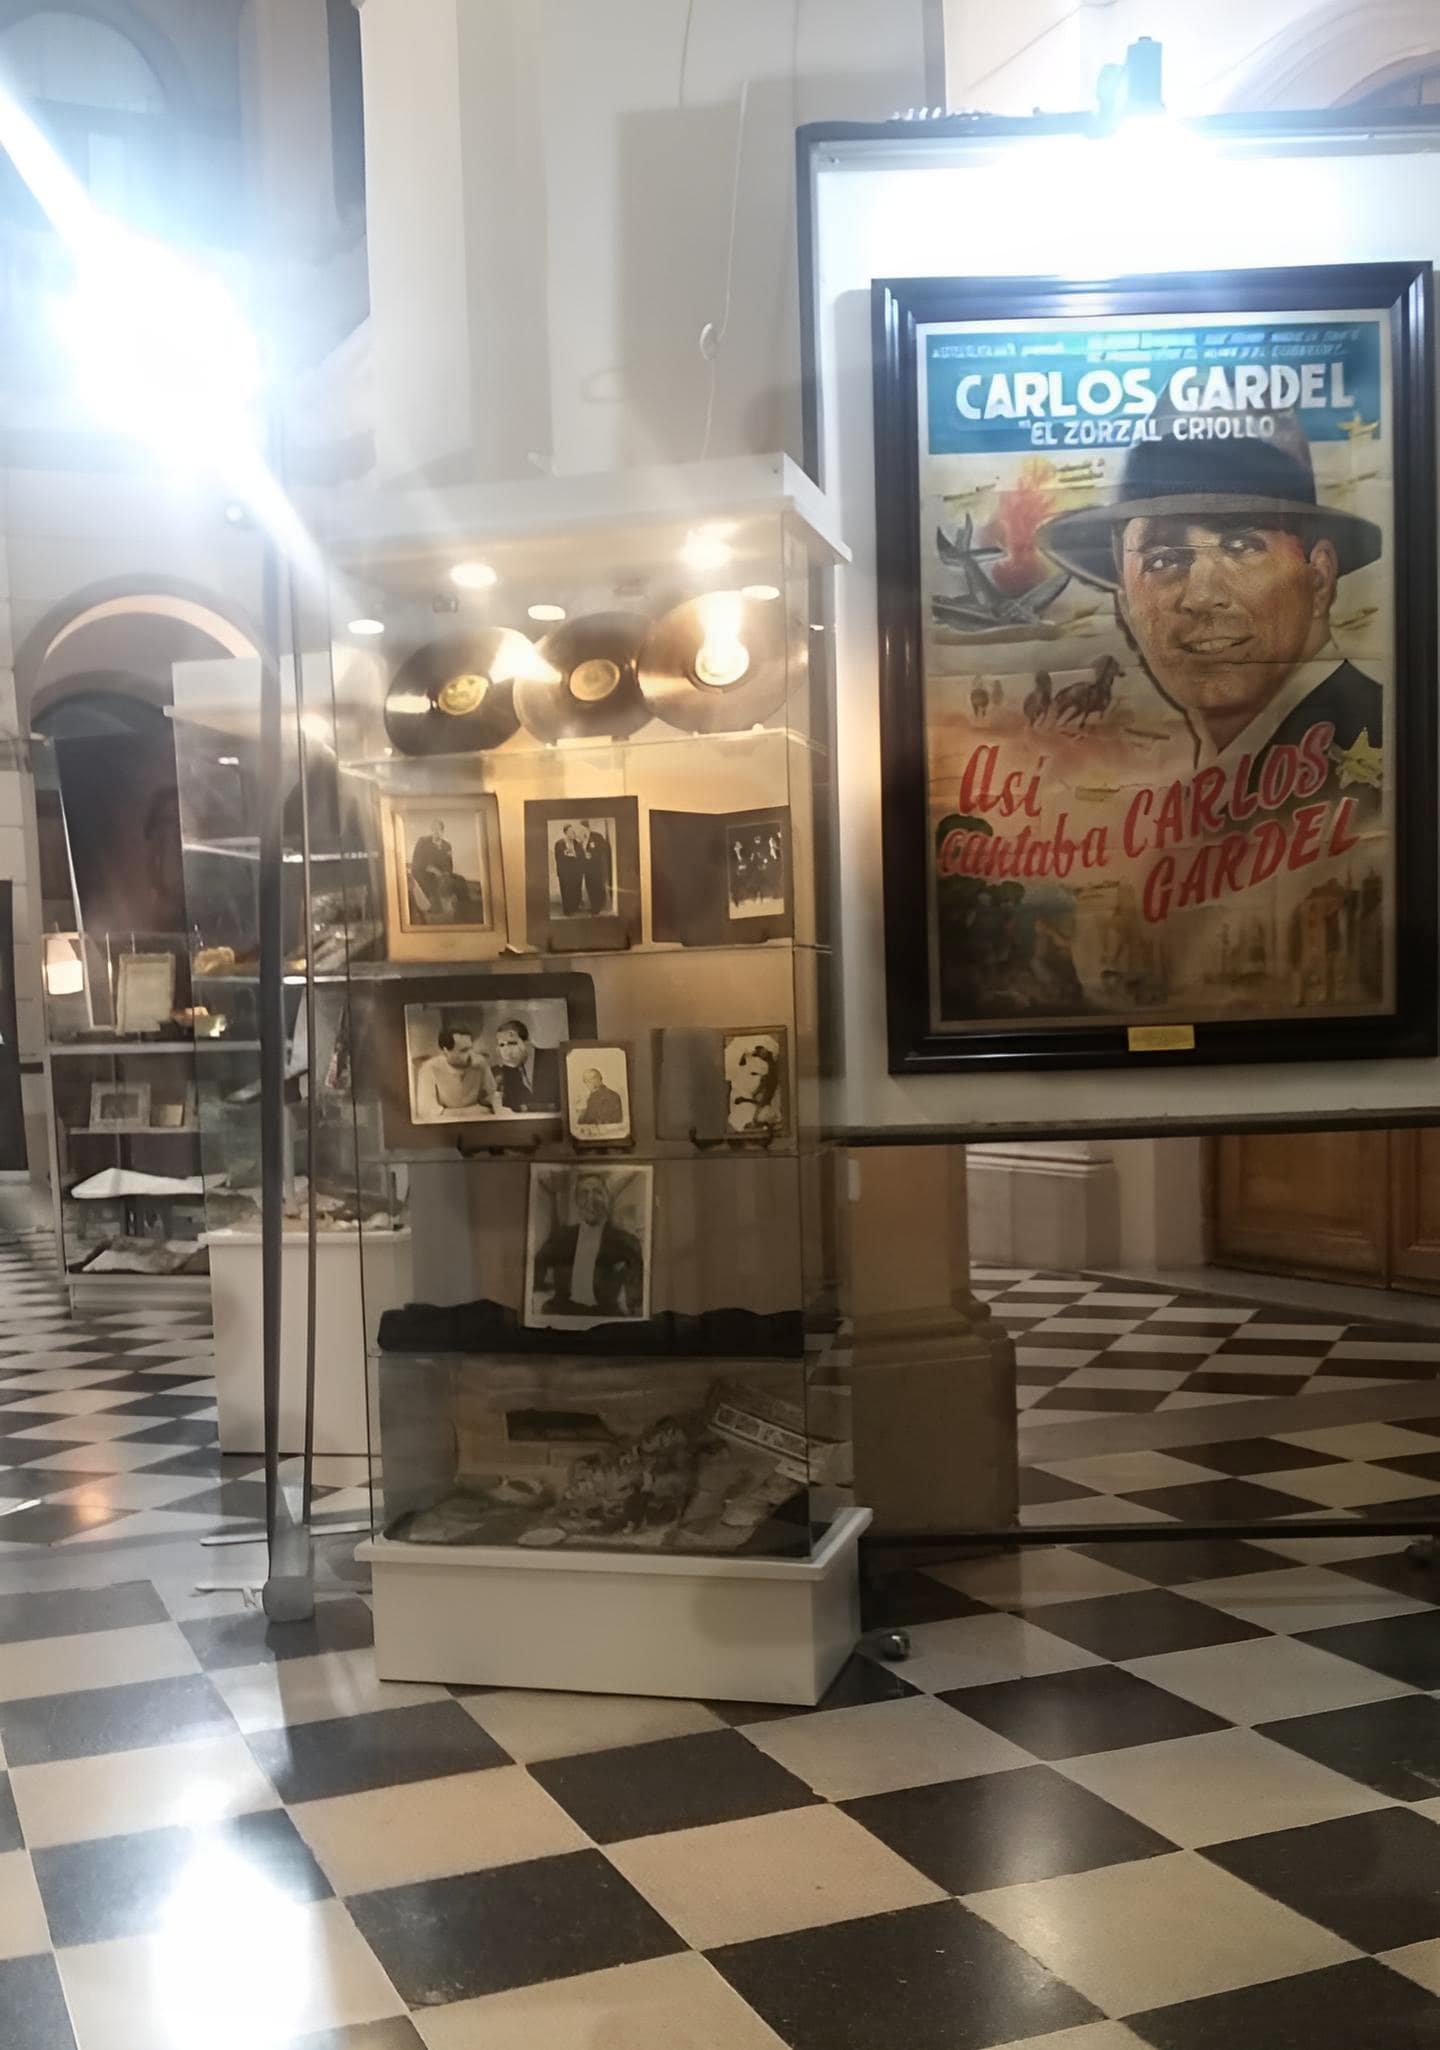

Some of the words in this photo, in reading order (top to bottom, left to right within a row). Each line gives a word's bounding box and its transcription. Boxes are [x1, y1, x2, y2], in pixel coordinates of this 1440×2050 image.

[955, 367, 1158, 421] CARLOS
[1169, 361, 1355, 412] GARDEL
[1063, 415, 1163, 446] ZORZAL
[937, 812, 1109, 880] cantaba
[1122, 721, 1335, 858] CARLOS
[1142, 796, 1361, 925] GARDEL
